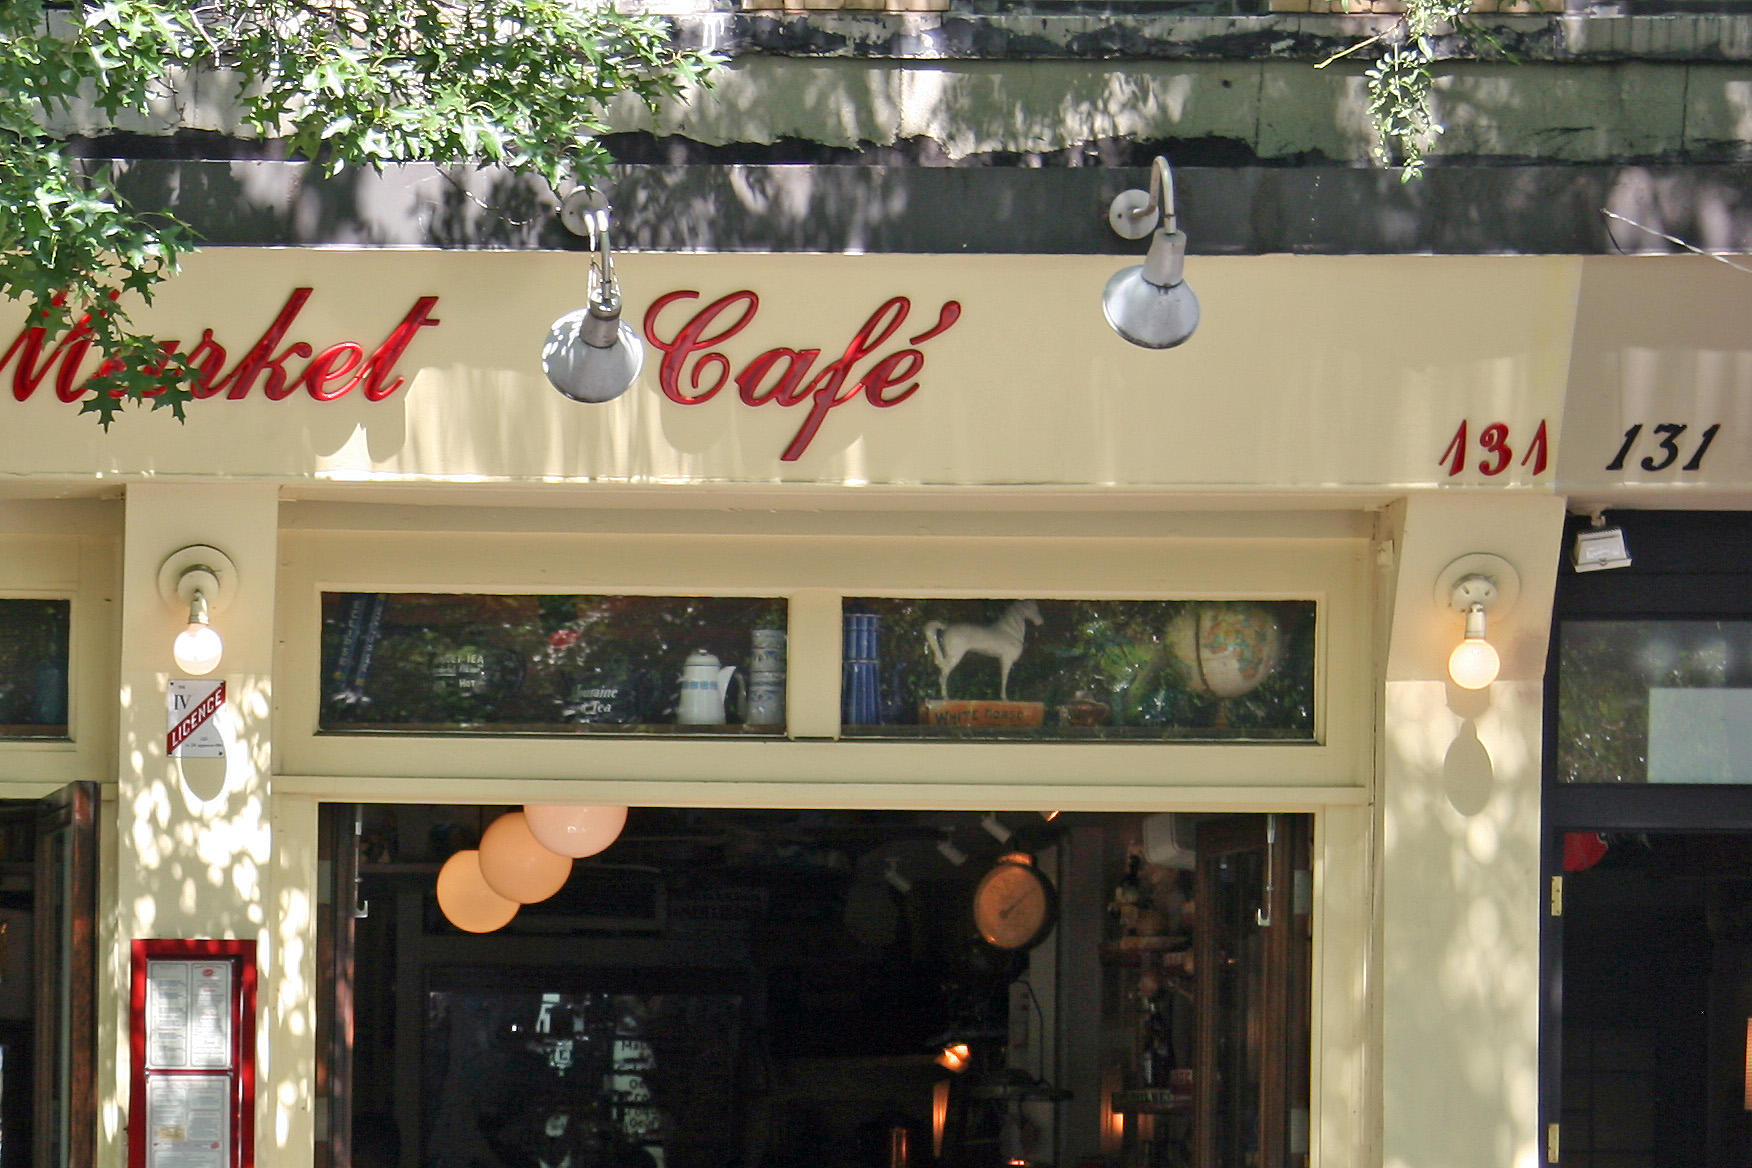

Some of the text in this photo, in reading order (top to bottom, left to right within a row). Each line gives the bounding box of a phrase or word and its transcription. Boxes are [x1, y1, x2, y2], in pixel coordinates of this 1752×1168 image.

[643, 289, 961, 461] Café
[1438, 419, 1548, 476] 131
[1605, 423, 1722, 471] 131
[172, 689, 222, 746] LICENCE
